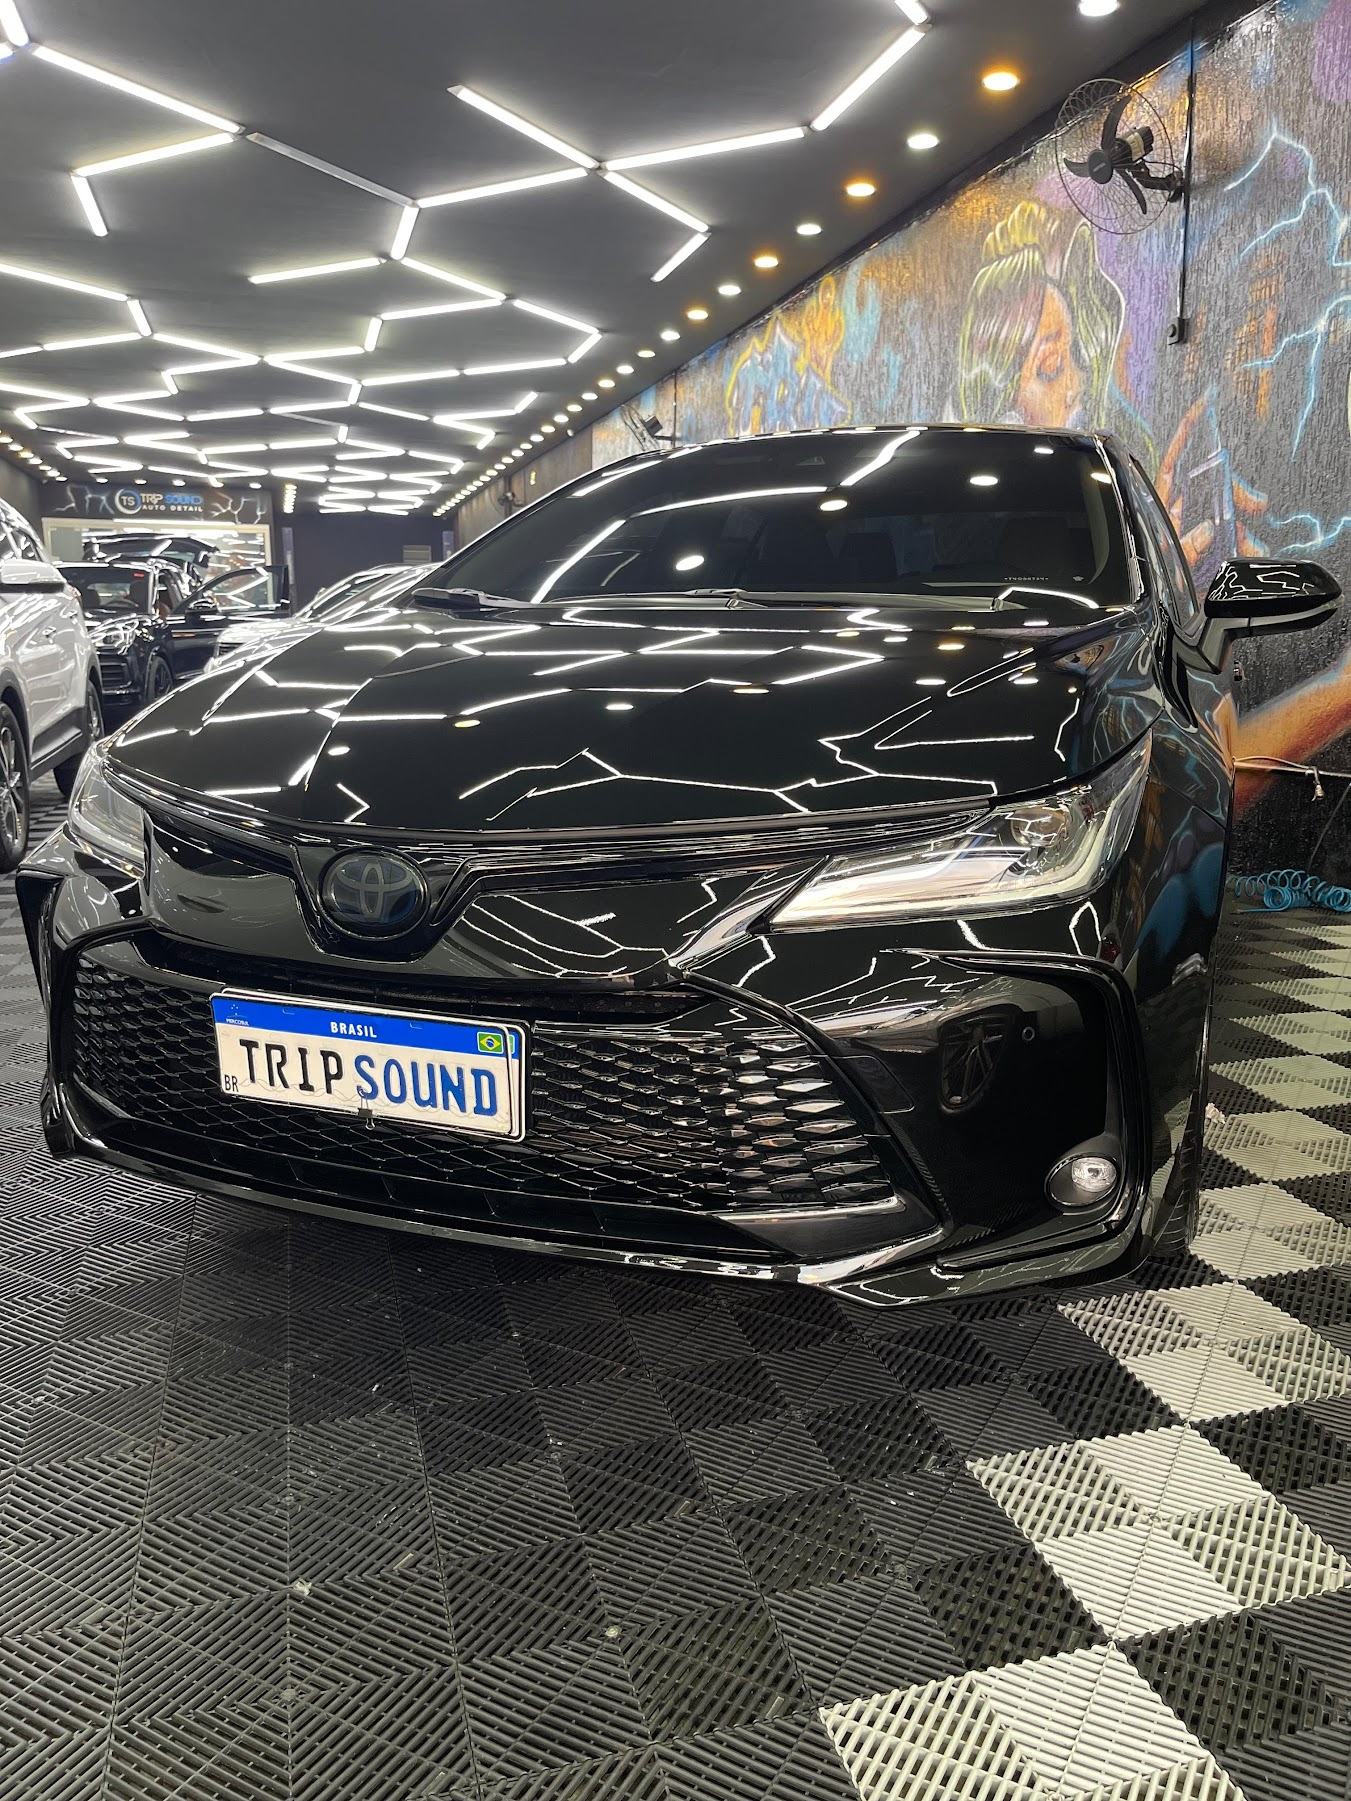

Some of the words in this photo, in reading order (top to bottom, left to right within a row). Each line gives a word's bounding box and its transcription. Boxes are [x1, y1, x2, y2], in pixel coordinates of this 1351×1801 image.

[121, 496, 136, 506] TS
[140, 493, 164, 505] TRIP
[165, 494, 203, 505] SOUND
[330, 1021, 377, 1038] BRASIL
[224, 1074, 239, 1092] BR
